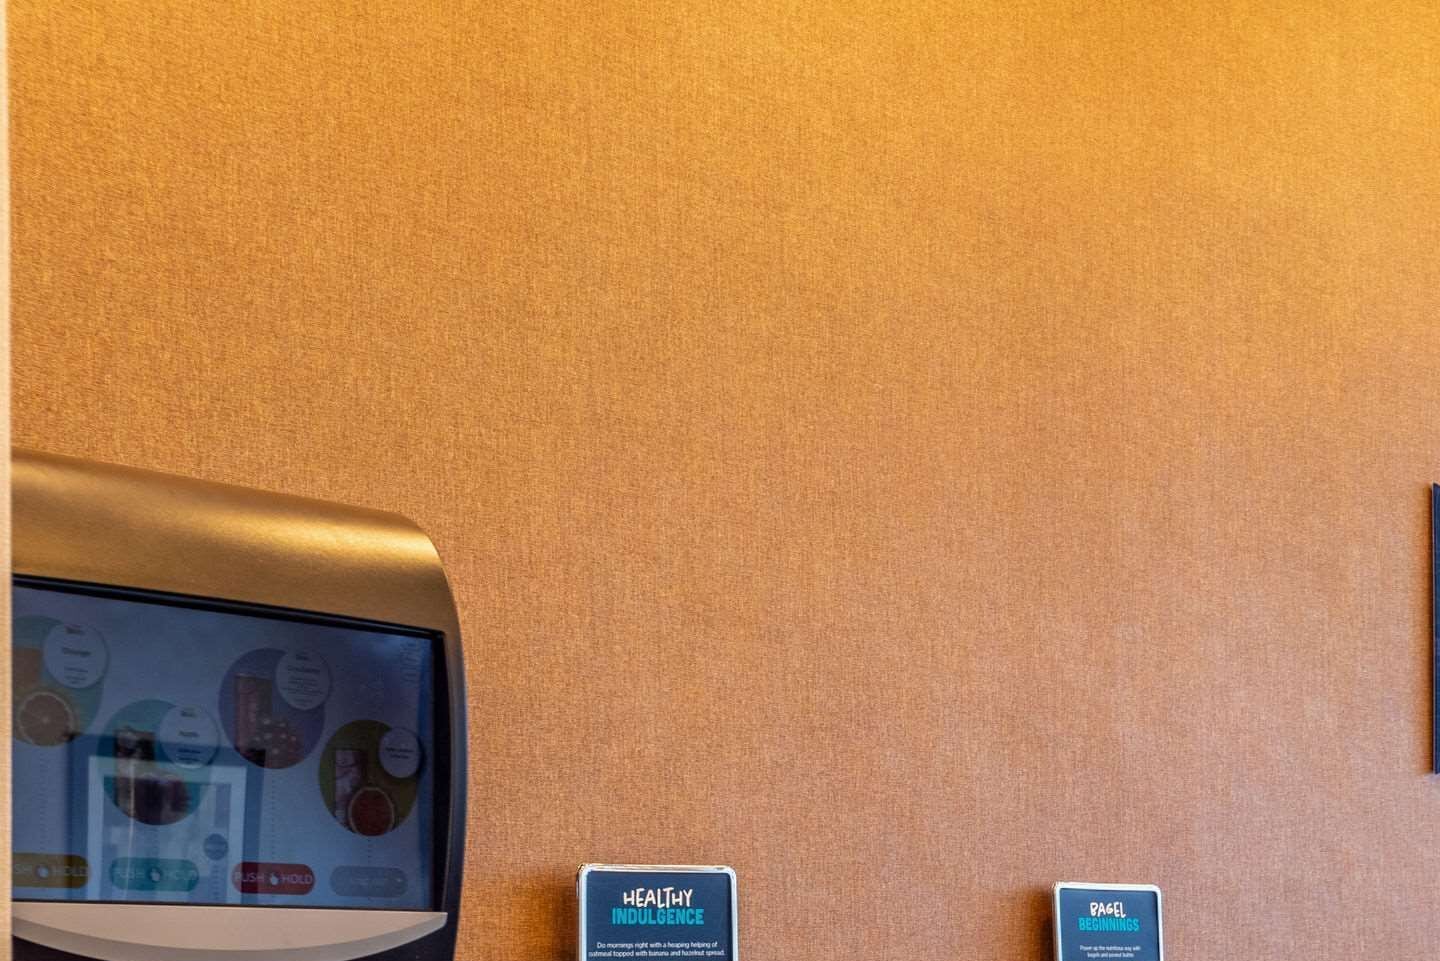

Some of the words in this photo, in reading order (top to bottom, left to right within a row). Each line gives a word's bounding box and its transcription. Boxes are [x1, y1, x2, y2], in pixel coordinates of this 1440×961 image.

[234, 871, 264, 882] PUSH
[282, 873, 313, 885] HOLD
[623, 887, 694, 909] HEALTHY
[611, 907, 705, 925] INDULGENCE
[1090, 901, 1127, 918] BAGEL
[1078, 917, 1140, 932] BEGINNINGS
[596, 941, 606, 949] Do
[607, 942, 634, 950] mornings
[634, 941, 648, 950] right
[649, 941, 662, 949] with
[667, 941, 690, 950] heaping
[690, 940, 711, 950] helping
[613, 950, 634, 958] topped
